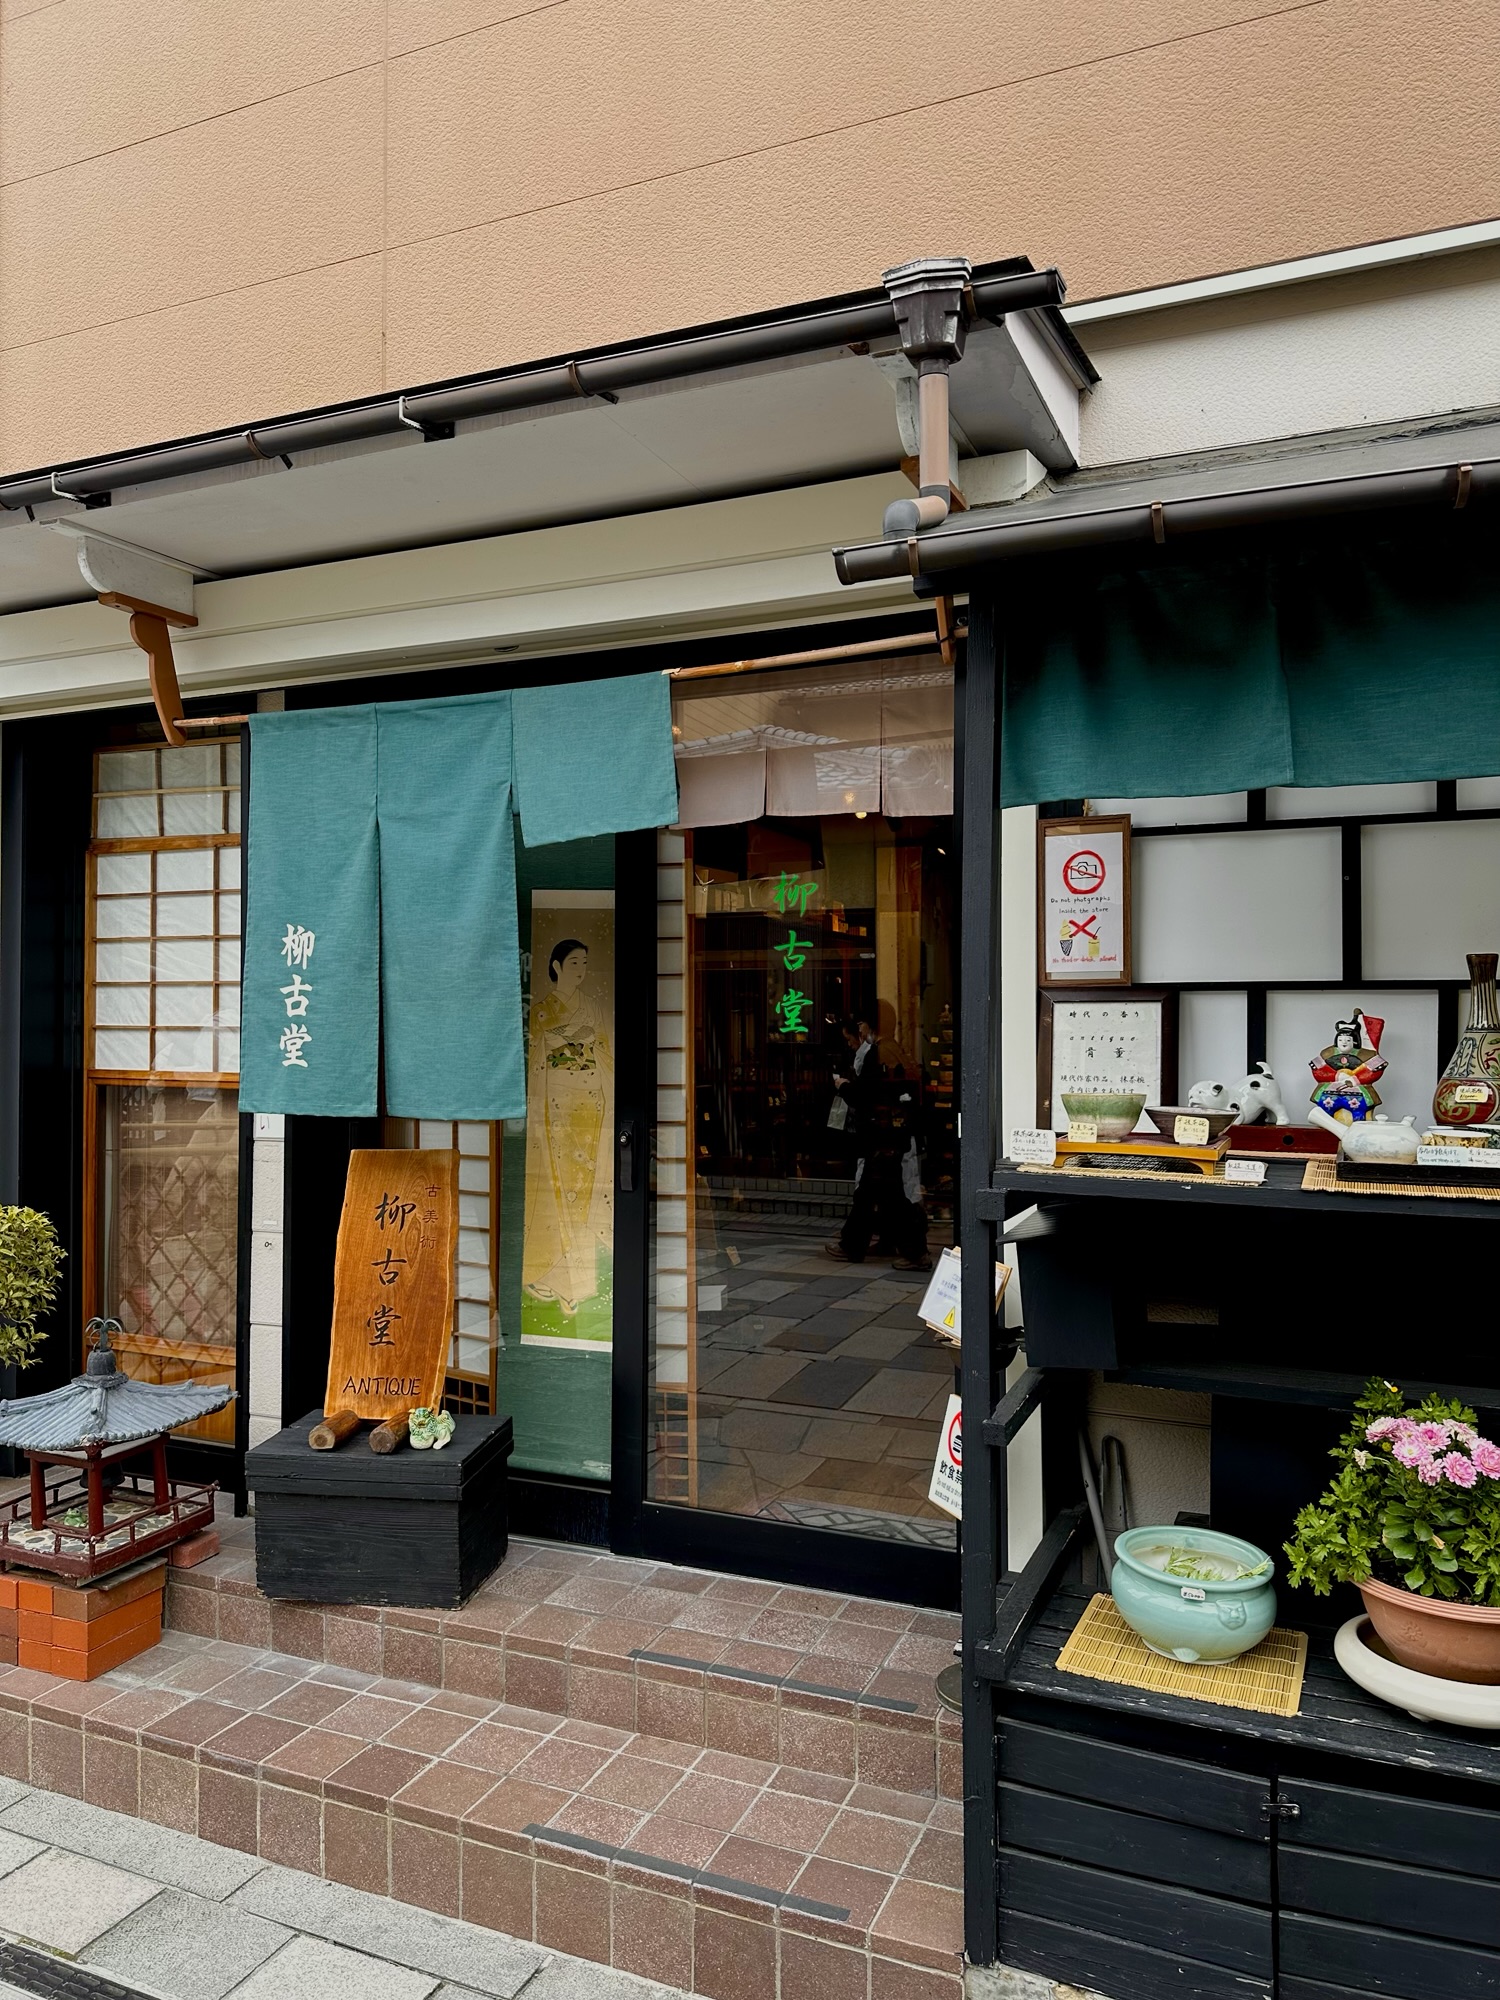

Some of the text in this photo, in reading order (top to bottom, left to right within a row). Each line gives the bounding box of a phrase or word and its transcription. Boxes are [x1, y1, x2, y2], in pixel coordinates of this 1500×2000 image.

[279, 923, 316, 1068] 柳古堂
[772, 870, 819, 1034] 柳古堂
[366, 1191, 417, 1347] 柳古堂
[420, 1183, 442, 1250] 古美術
[342, 1375, 422, 1397] ANTIQUE
